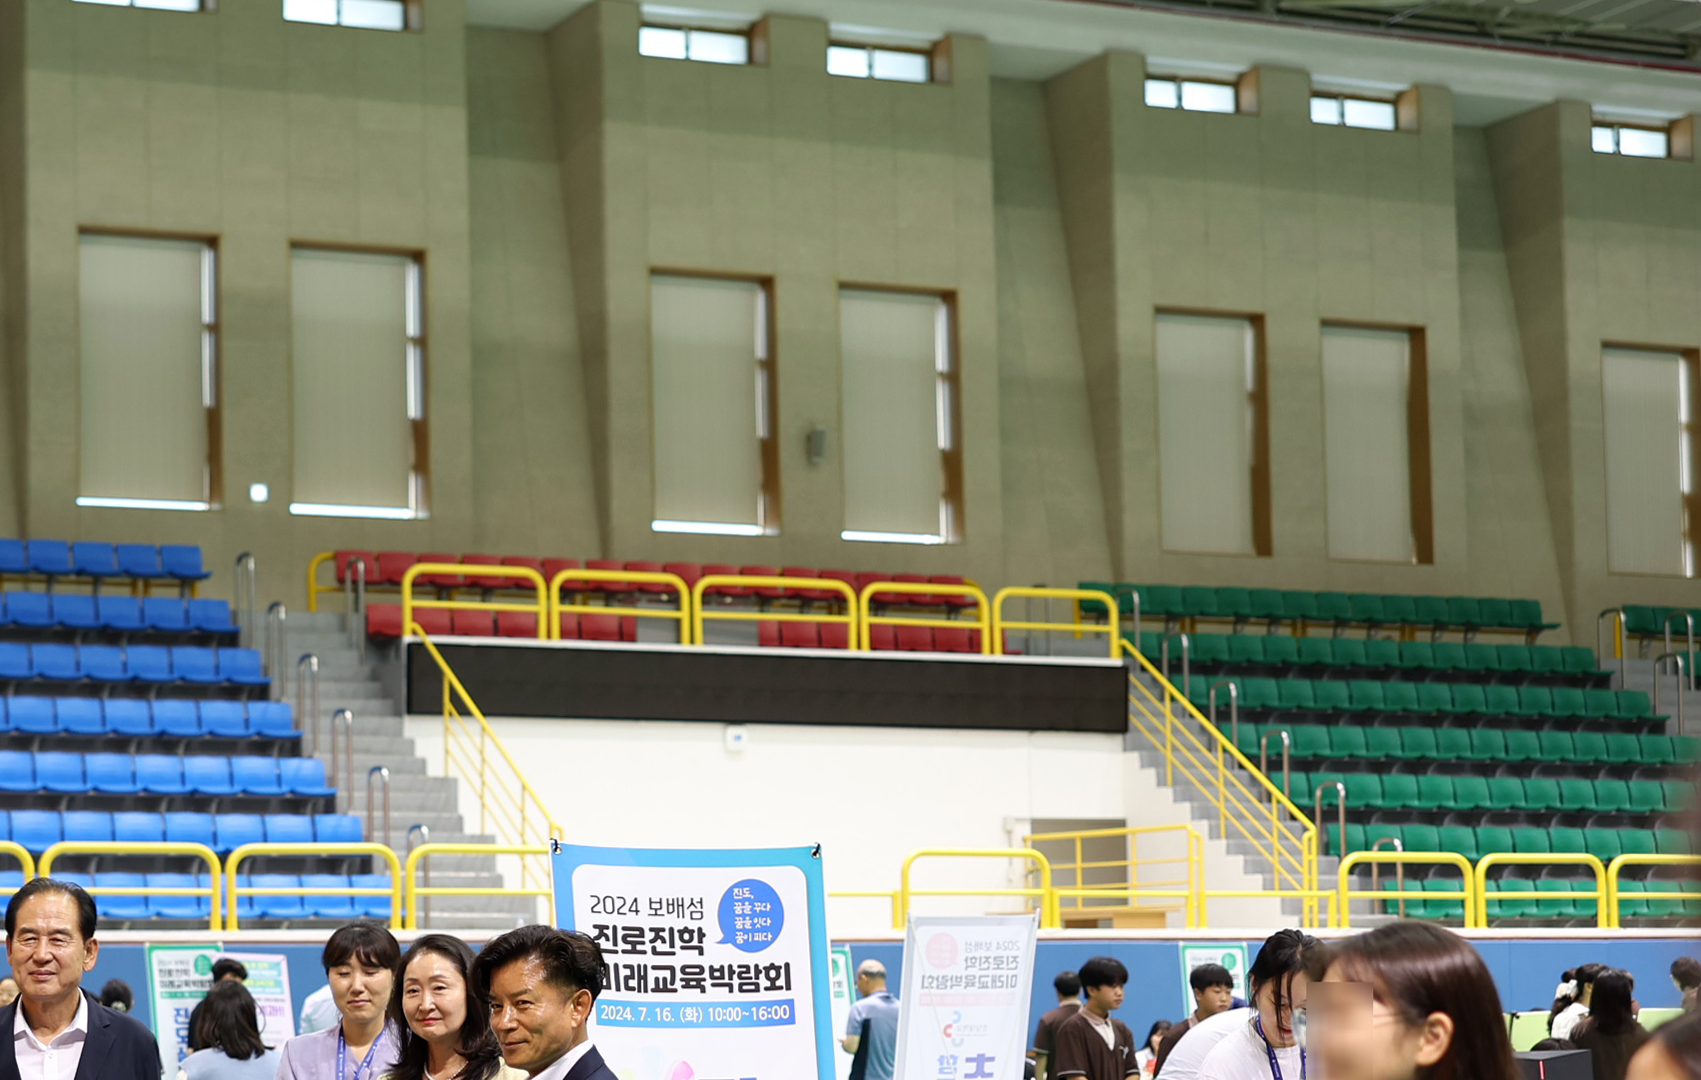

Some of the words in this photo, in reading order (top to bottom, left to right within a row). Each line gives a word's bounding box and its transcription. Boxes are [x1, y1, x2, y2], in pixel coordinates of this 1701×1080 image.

[733, 887, 755, 899] 진도,
[590, 895, 640, 916] 2024
[647, 897, 704, 920] 보배섬
[733, 901, 753, 914] 꿈을
[754, 902, 772, 914] 꾸다
[734, 916, 753, 929] 꿈을
[592, 924, 706, 956] 진로진학
[735, 931, 752, 944] 꿈이
[753, 932, 773, 942] 피다
[601, 962, 792, 994] 미래교육박람회
[601, 1005, 635, 1021] 2024.
[638, 1007, 651, 1022] 7.
[655, 1007, 675, 1022] 16.
[680, 1006, 703, 1023] (화)
[708, 1004, 790, 1022] 10:00~16:00
